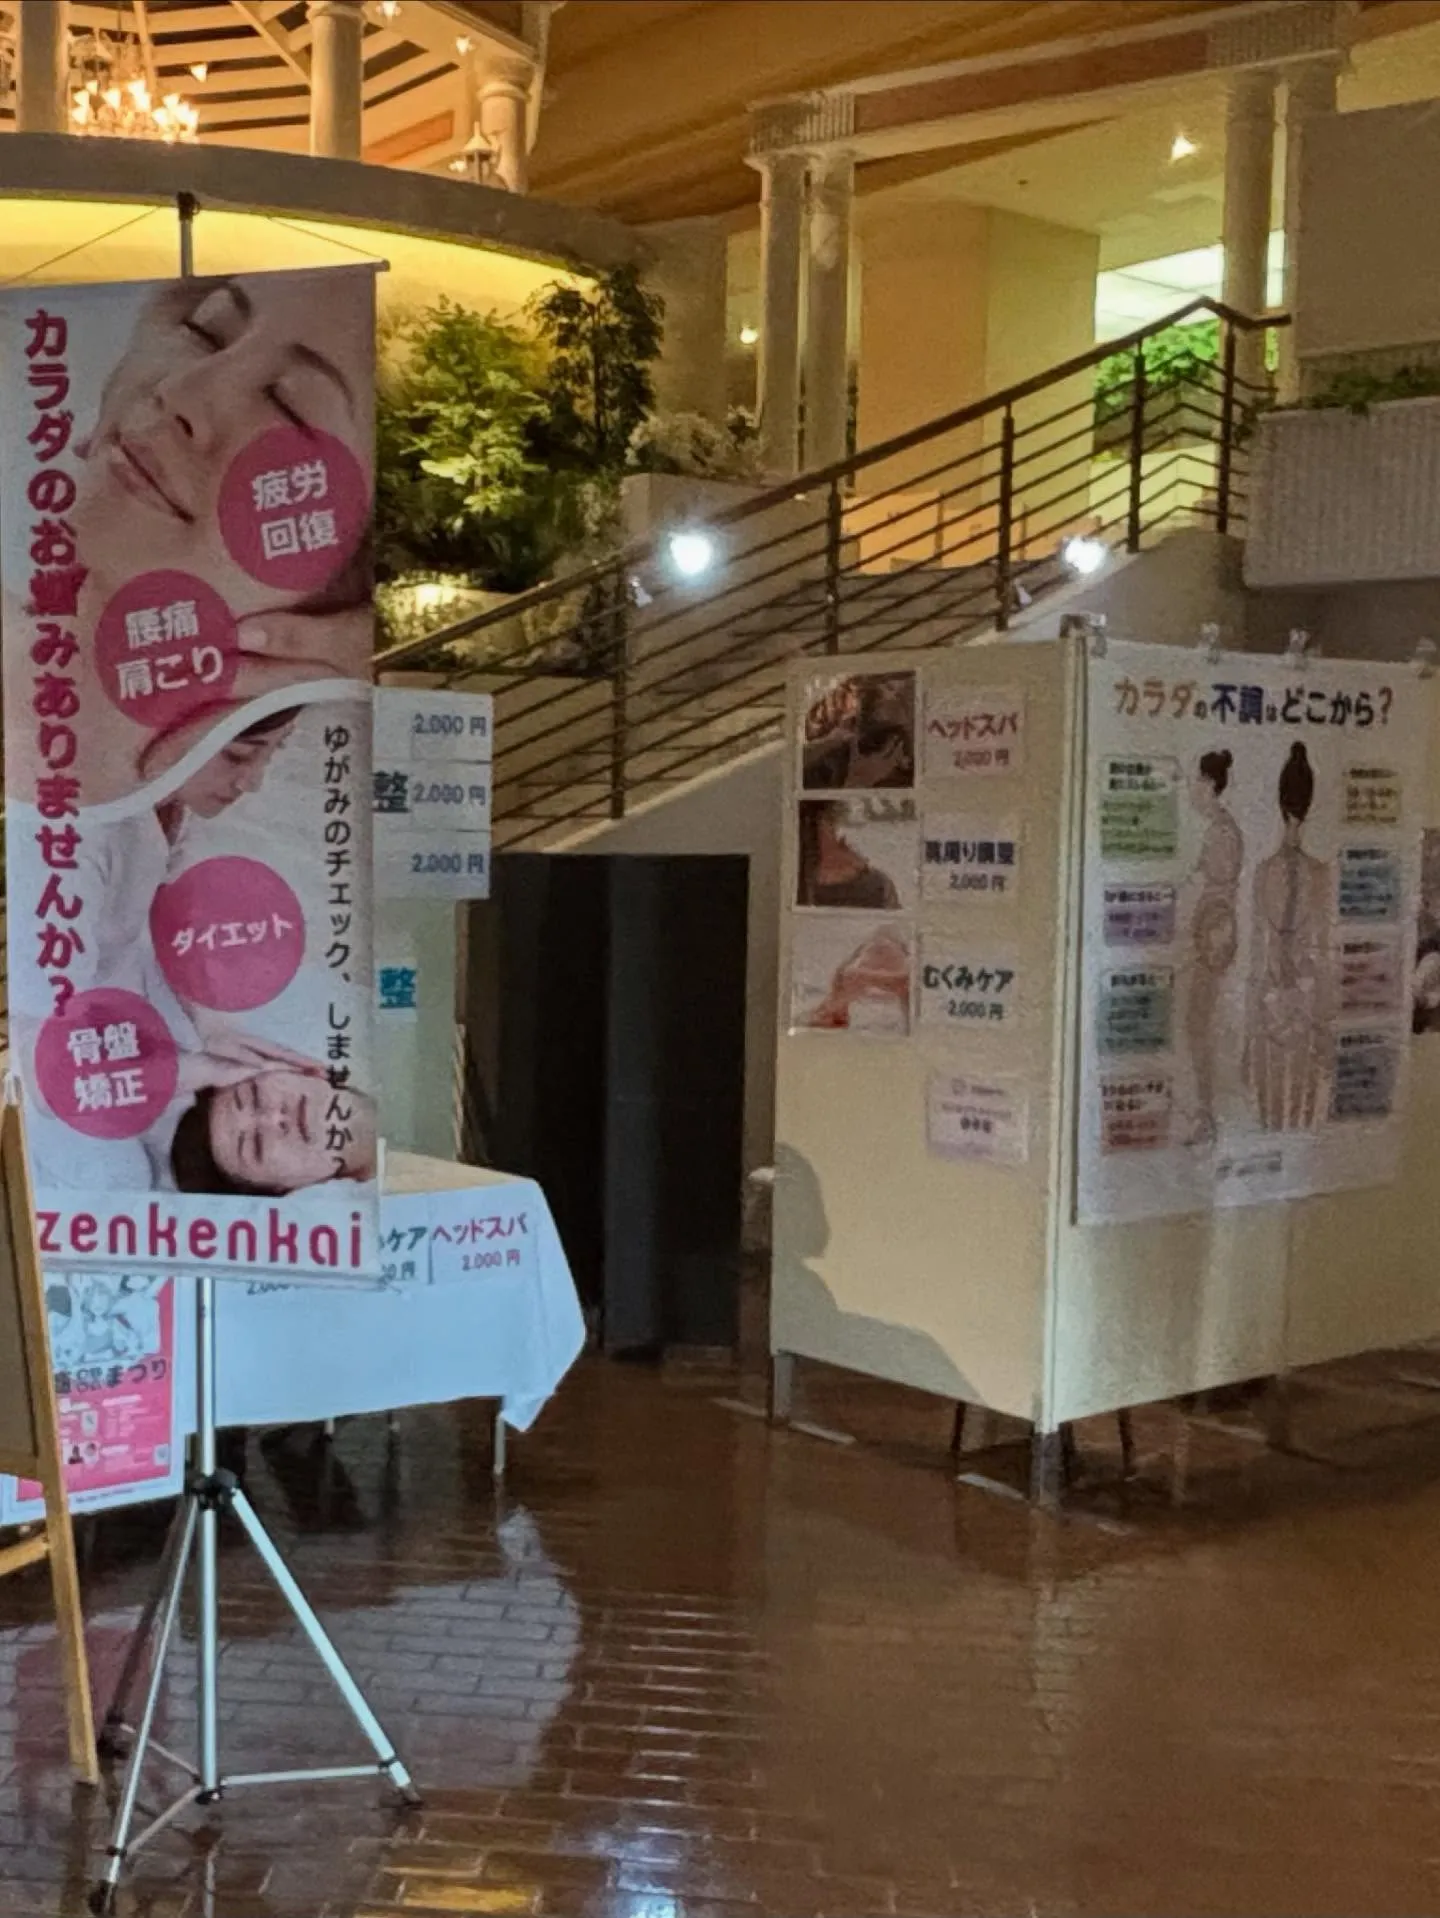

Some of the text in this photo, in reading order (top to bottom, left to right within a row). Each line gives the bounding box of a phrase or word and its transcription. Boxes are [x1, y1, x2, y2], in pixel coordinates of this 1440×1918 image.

[251, 459, 329, 512] 疲労
[261, 508, 340, 560] 回復
[125, 599, 199, 650] 腰痛
[115, 645, 224, 700] 肩こり
[171, 913, 294, 956] ダイエット
[922, 964, 1014, 992] むくみケア
[67, 1021, 142, 1068] 骨盤
[74, 1067, 149, 1113] 矯正
[36, 1201, 362, 1269] zenkenkai
[431, 1212, 528, 1245] ヘッドスパ
